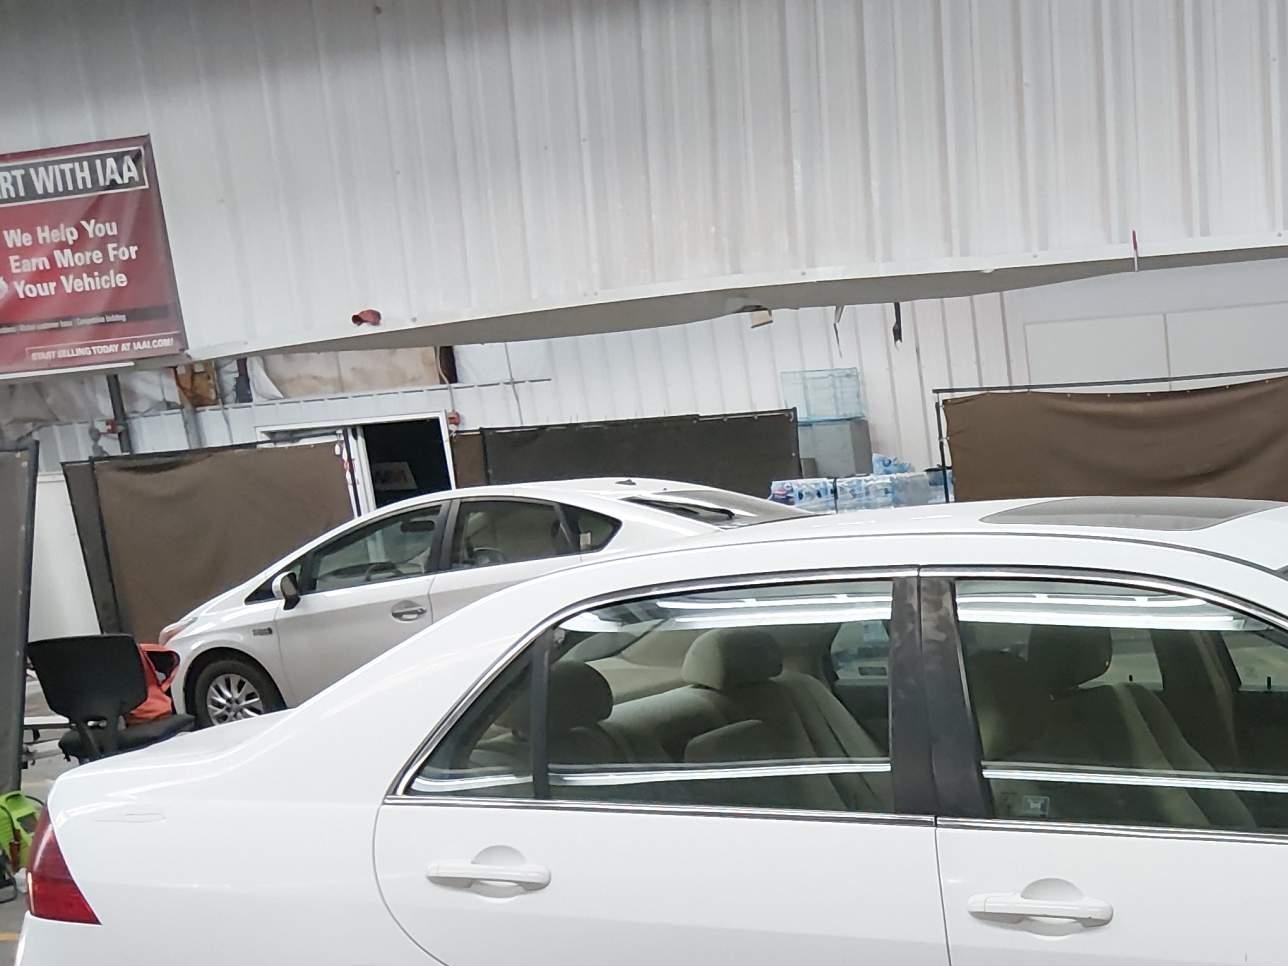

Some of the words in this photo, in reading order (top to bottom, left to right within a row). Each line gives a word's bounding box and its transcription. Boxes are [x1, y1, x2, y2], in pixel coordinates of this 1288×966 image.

[0, 169, 25, 199] RT
[29, 161, 92, 195] WITH
[95, 155, 139, 187] IAA
[3, 228, 33, 248] We
[36, 223, 79, 246] Help
[80, 219, 118, 239] You
[9, 255, 51, 273] Earn
[53, 248, 104, 268] More
[107, 243, 138, 262] For
[13, 280, 57, 299] Your
[60, 269, 128, 294] Vehicle
[91, 343, 119, 355] TODAY
[121, 341, 131, 352] AT
